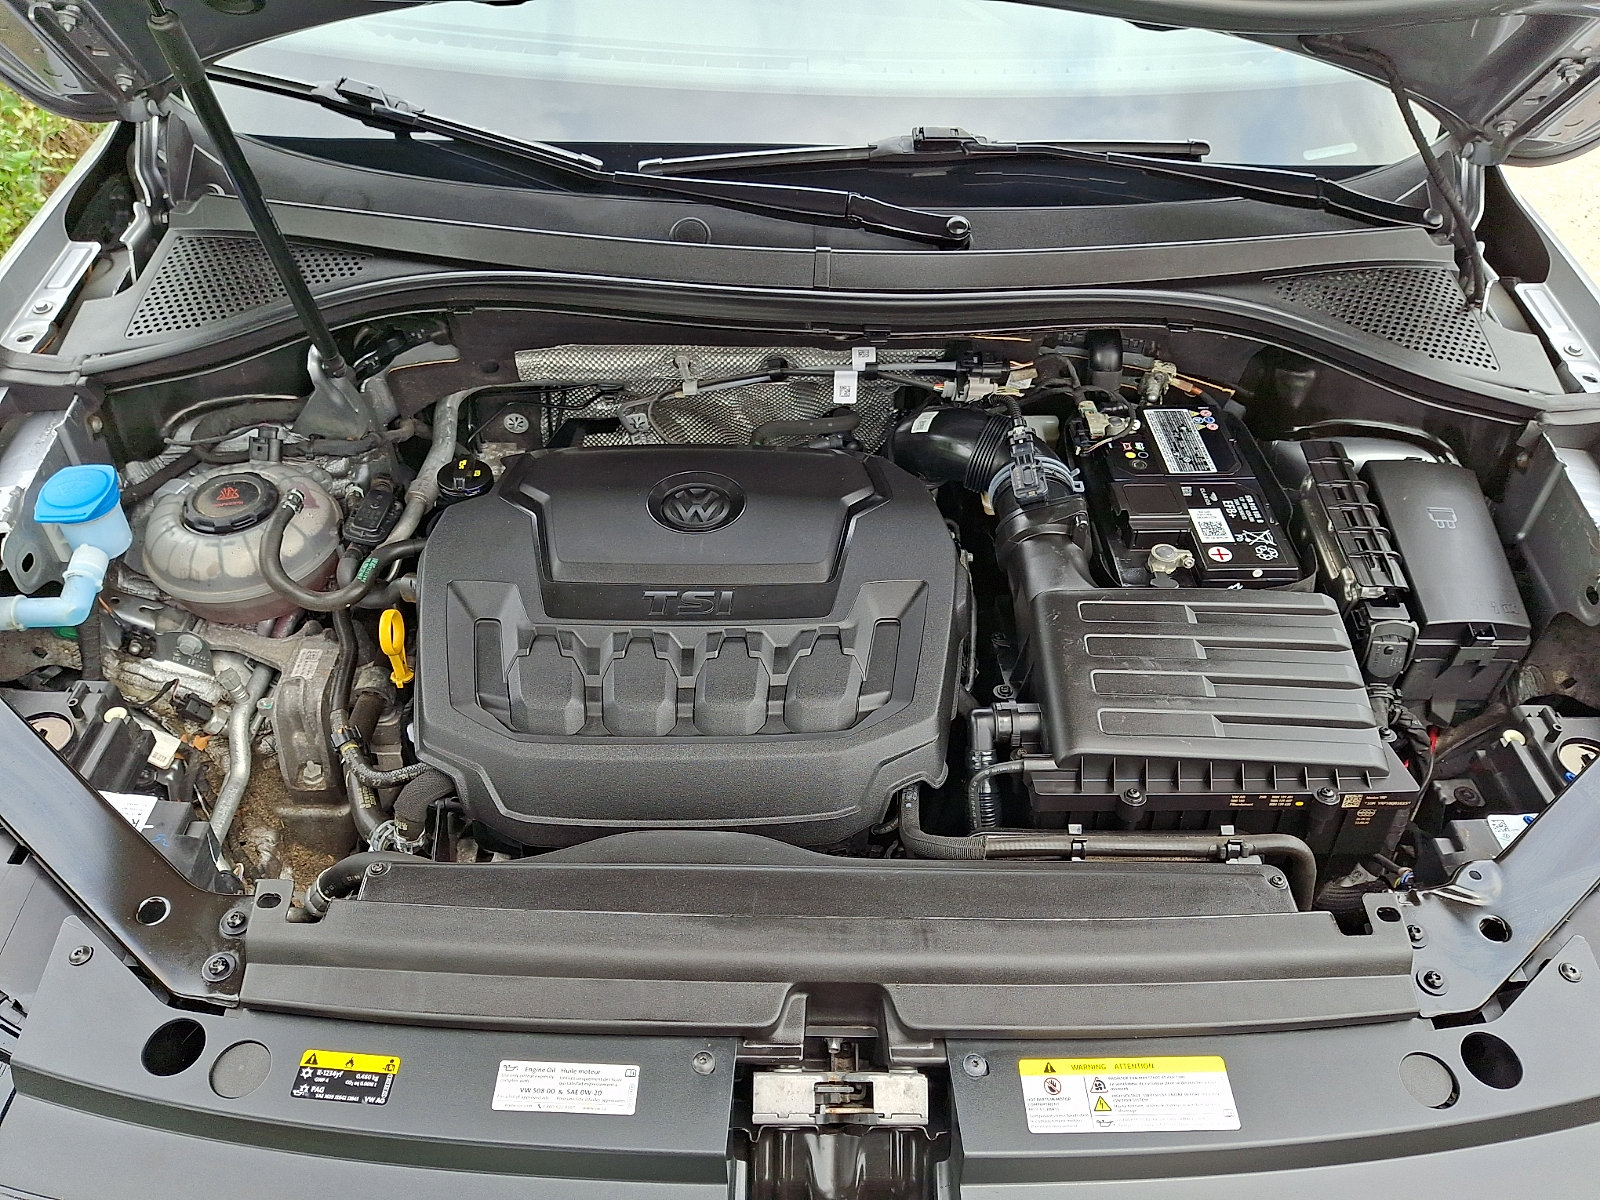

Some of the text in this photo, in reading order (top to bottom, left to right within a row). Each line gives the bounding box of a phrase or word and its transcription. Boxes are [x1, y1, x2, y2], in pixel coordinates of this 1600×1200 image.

[1221, 500, 1238, 519] EFB+
[641, 590, 734, 615] TSI
[524, 1066, 546, 1075] Engine
[560, 1067, 577, 1075] Huile
[1070, 1063, 1107, 1071] WARNING
[316, 1069, 344, 1079] R-1234yf
[310, 1085, 326, 1094] PAG
[566, 1088, 579, 1096] SAE
[364, 1095, 386, 1105] VW AG
